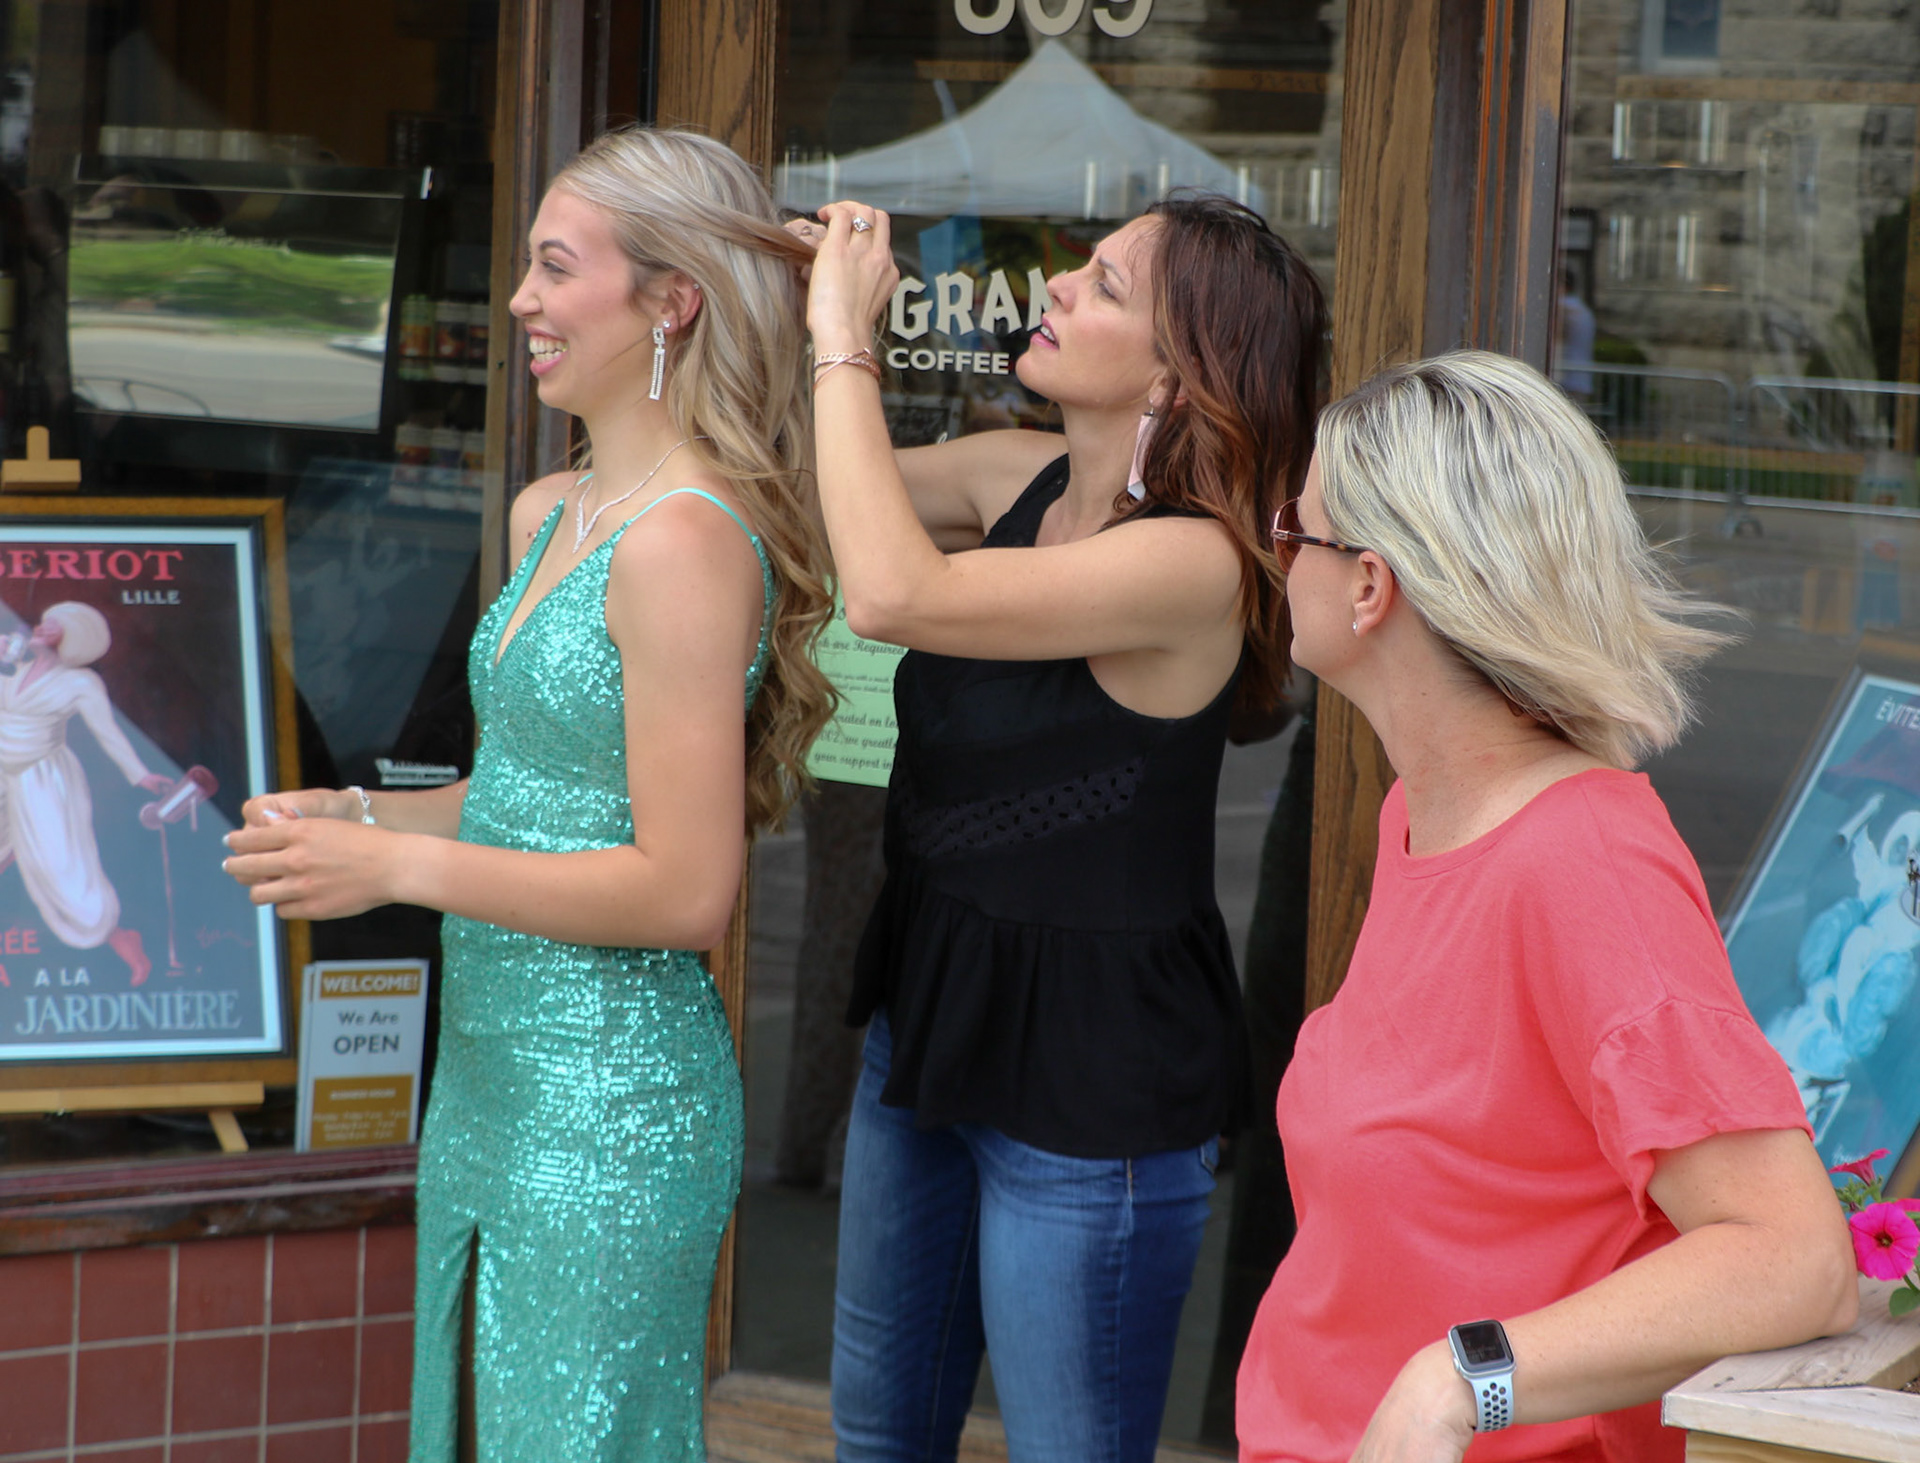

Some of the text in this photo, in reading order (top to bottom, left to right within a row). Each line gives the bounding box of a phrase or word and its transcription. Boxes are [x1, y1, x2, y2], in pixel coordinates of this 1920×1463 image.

[886, 346, 1010, 375] COFFEE
[0, 549, 184, 581] ERIOT
[121, 589, 181, 605] LILLE
[34, 966, 91, 988] A LA
[322, 973, 419, 993] WELCOME!
[337, 1009, 400, 1026] We Are
[333, 1034, 401, 1056] OPEN
